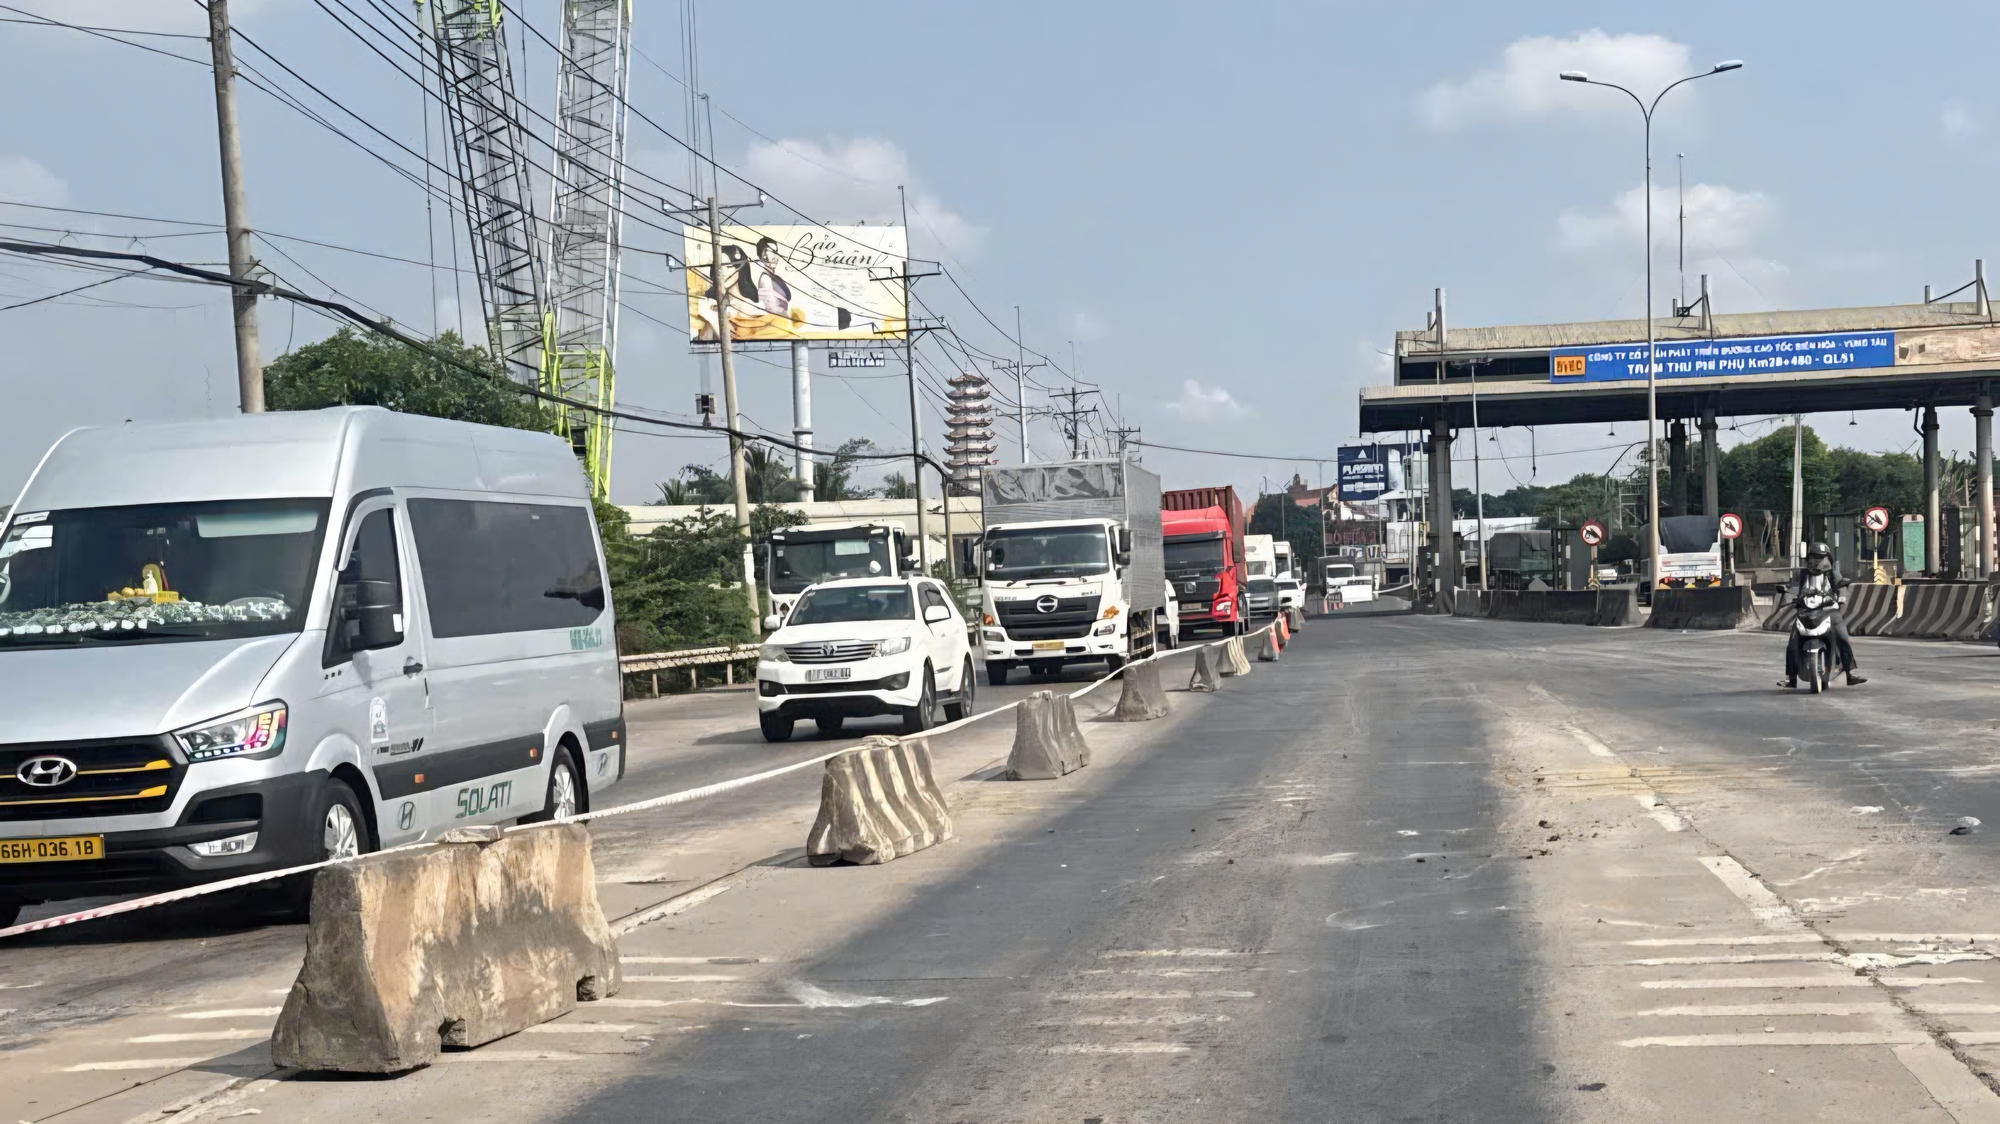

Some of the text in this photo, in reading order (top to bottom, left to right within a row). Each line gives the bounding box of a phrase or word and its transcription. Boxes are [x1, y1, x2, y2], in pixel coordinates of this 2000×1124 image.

[1614, 352, 1626, 360] TY
[1643, 347, 1667, 359] PẦN
[1667, 361, 1691, 373] THU
[1719, 358, 1745, 375] PHỤ
[455, 780, 513, 818] SOLATI
